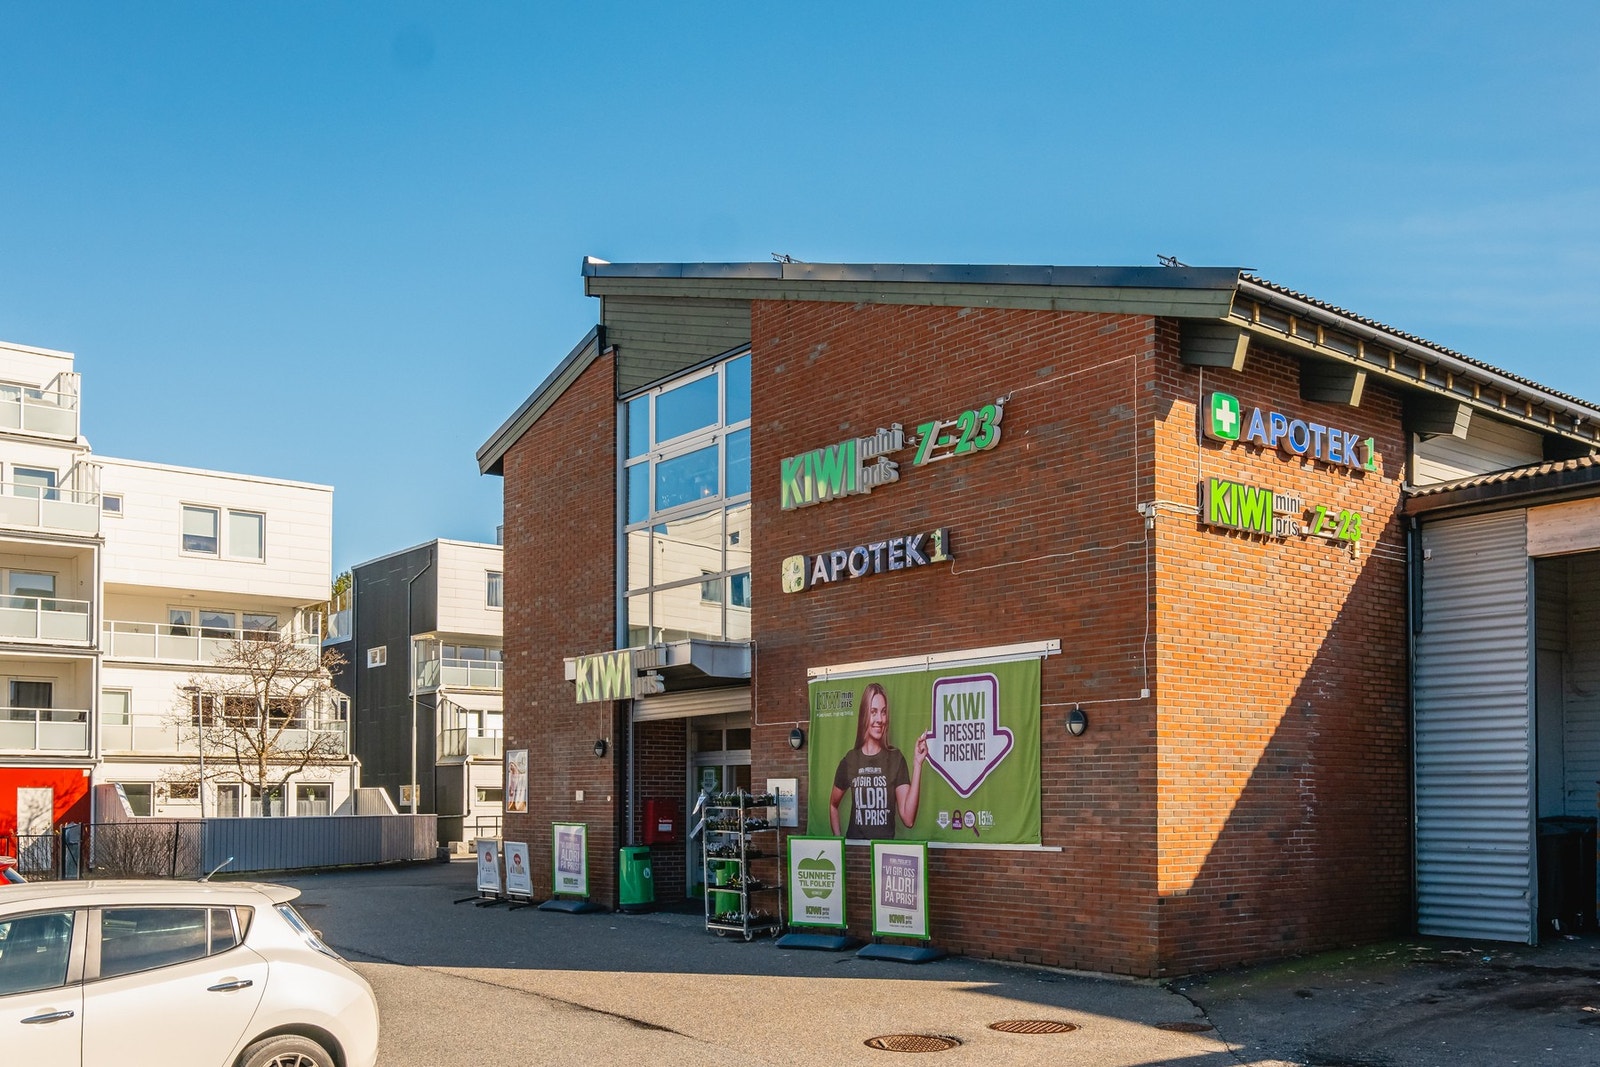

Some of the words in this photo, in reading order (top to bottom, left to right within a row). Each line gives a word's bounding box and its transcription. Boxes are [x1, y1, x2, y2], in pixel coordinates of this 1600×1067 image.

[1247, 407, 1361, 468] APOTEK
[1364, 437, 1377, 471] 1
[781, 438, 857, 510] KIWI
[861, 428, 897, 454] mini
[913, 404, 997, 465] 7-23
[861, 461, 894, 491] pris
[1209, 478, 1274, 535] KIWI
[1275, 492, 1300, 513] mini
[1314, 505, 1362, 542] 7-23
[1275, 516, 1299, 536] pris
[811, 533, 928, 585] APOTEK
[930, 528, 948, 563] 1
[576, 652, 631, 704] KIWI
[943, 691, 985, 721] KIWI
[944, 722, 985, 742] PRESSER
[944, 743, 985, 762] PRISENE!
[873, 775, 887, 787] OSS
[560, 848, 580, 863] ALDRI
[798, 871, 836, 880] SUNNHET
[893, 866, 903, 876] GIR
[904, 867, 916, 878] OSS
[810, 880, 835, 888] FOLKET
[885, 875, 915, 894] ALDRI
